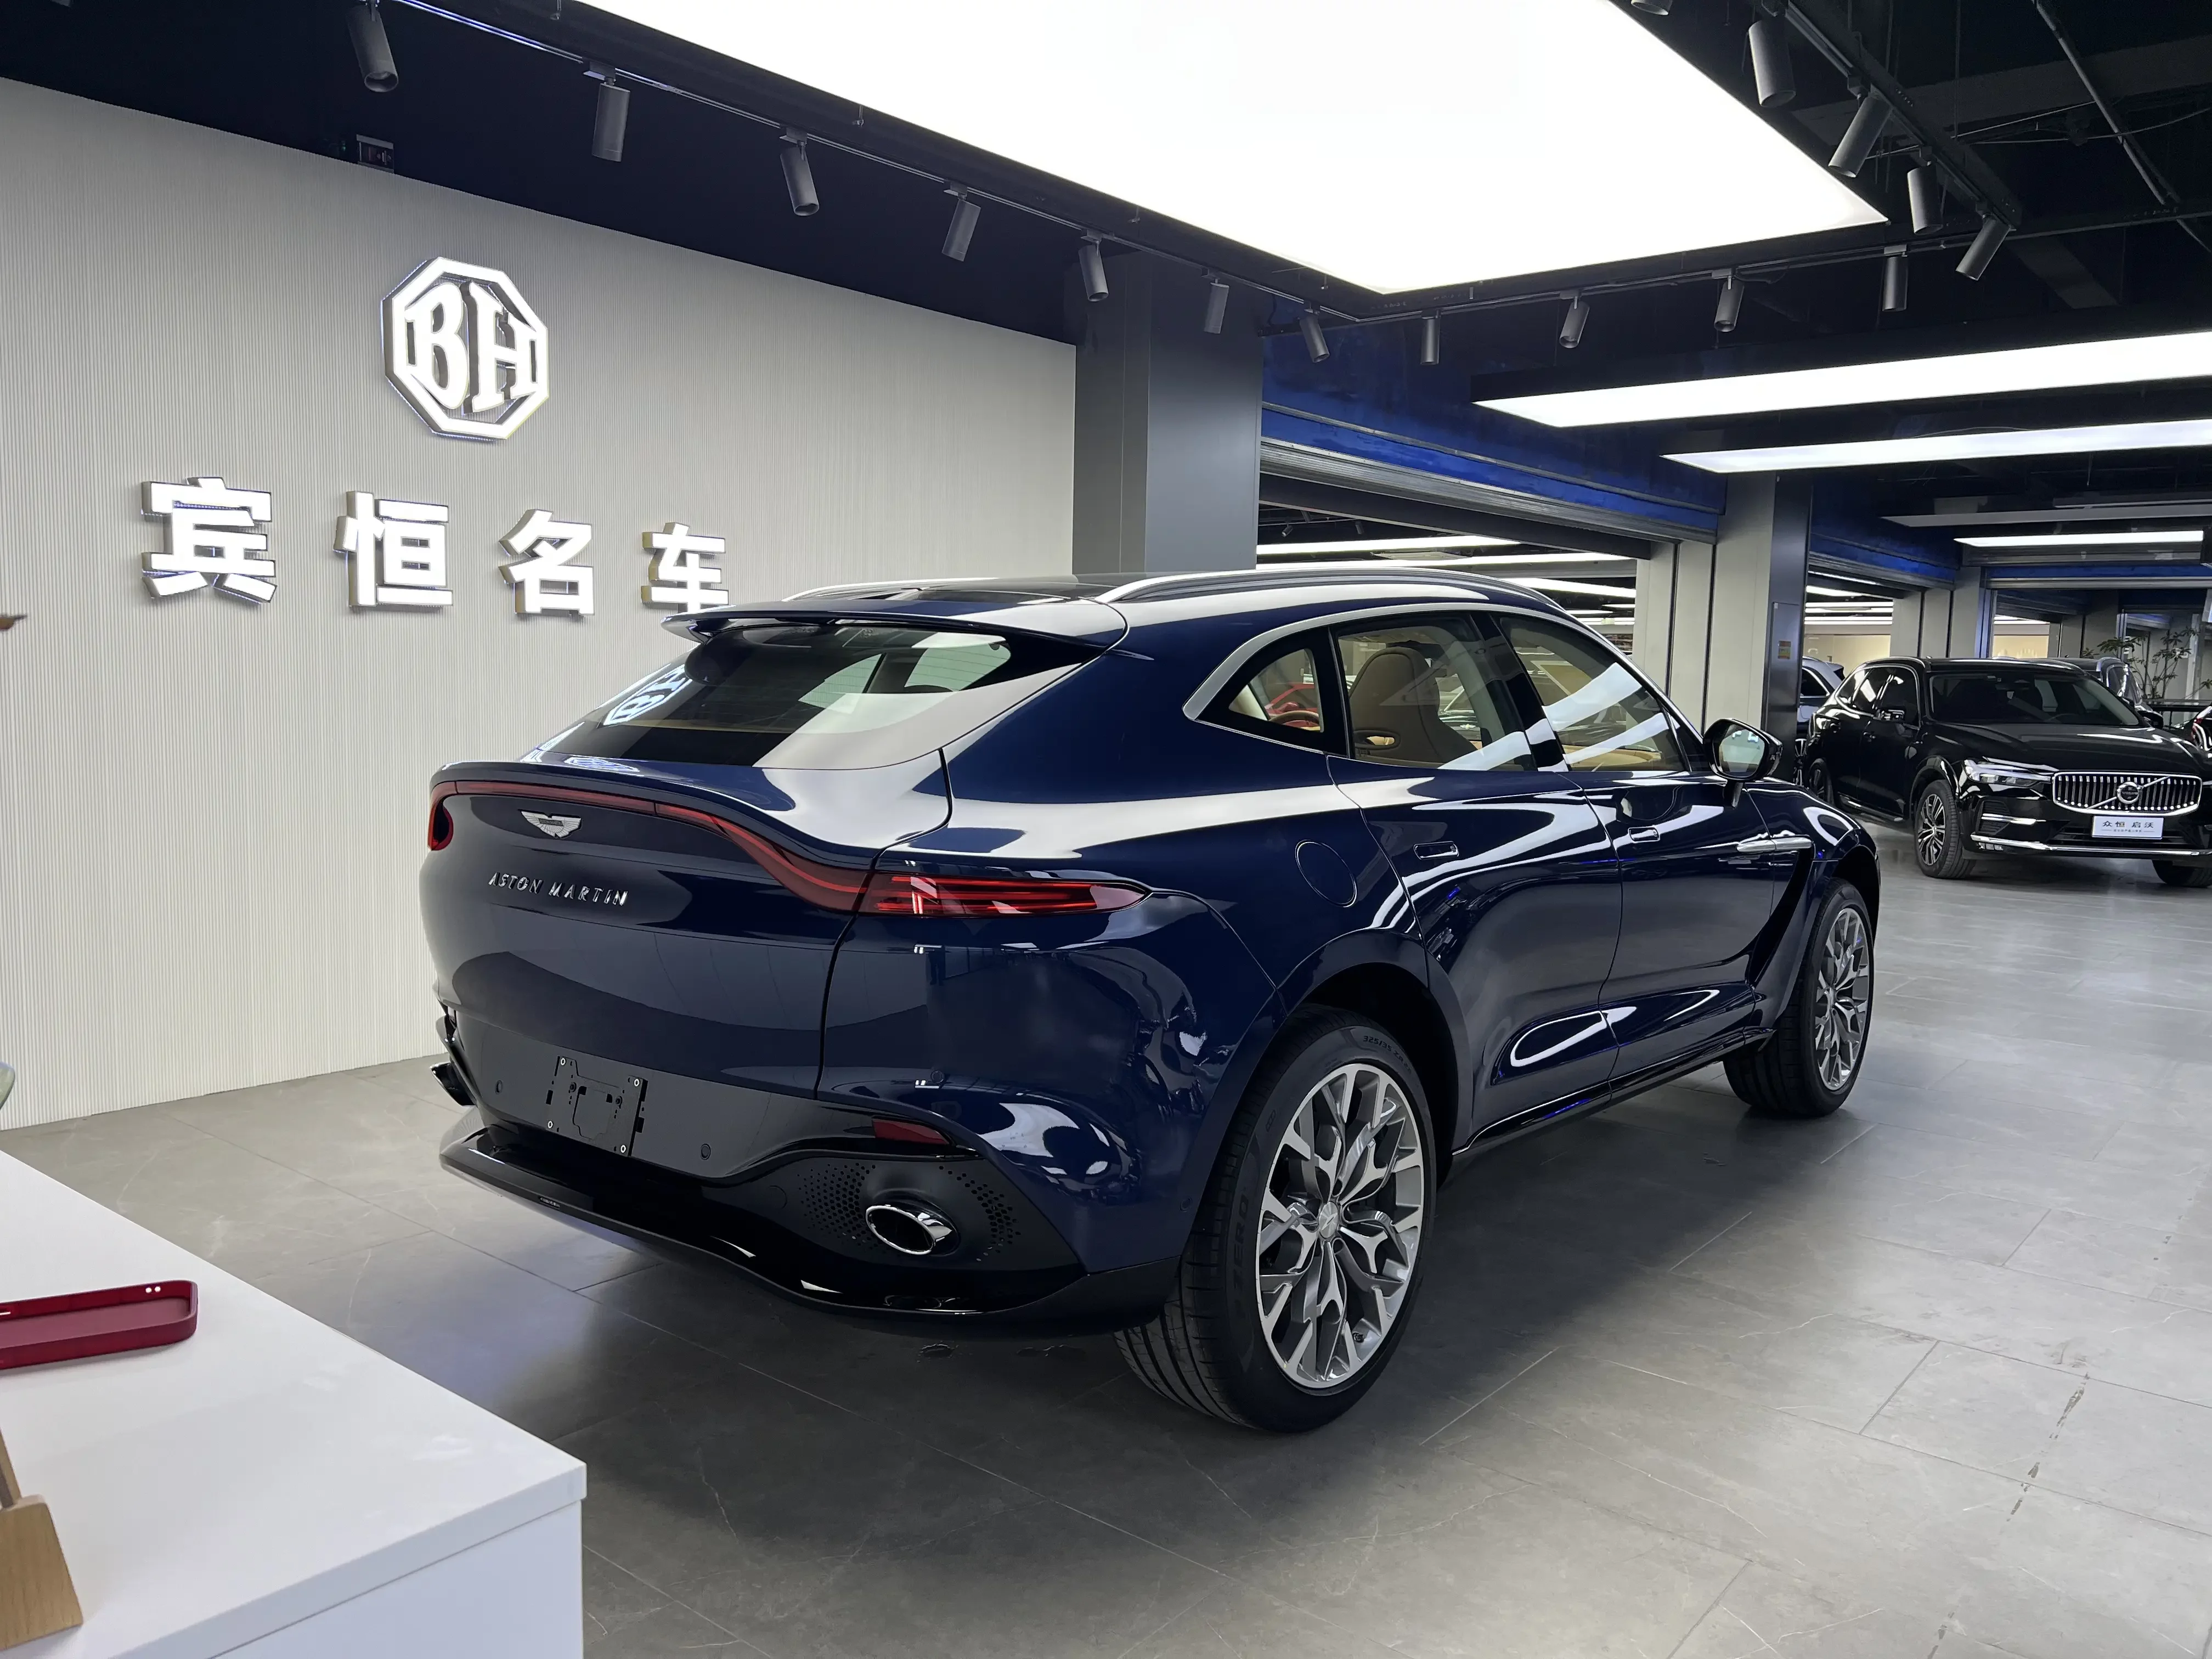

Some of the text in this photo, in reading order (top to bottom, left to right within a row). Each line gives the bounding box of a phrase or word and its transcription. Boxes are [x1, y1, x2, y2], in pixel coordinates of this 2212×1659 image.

[404, 280, 539, 413] BH
[142, 476, 729, 616] 宾恒名车
[488, 872, 628, 906] ASTON MARTIN
[1362, 1035, 1392, 1052] 325/35
